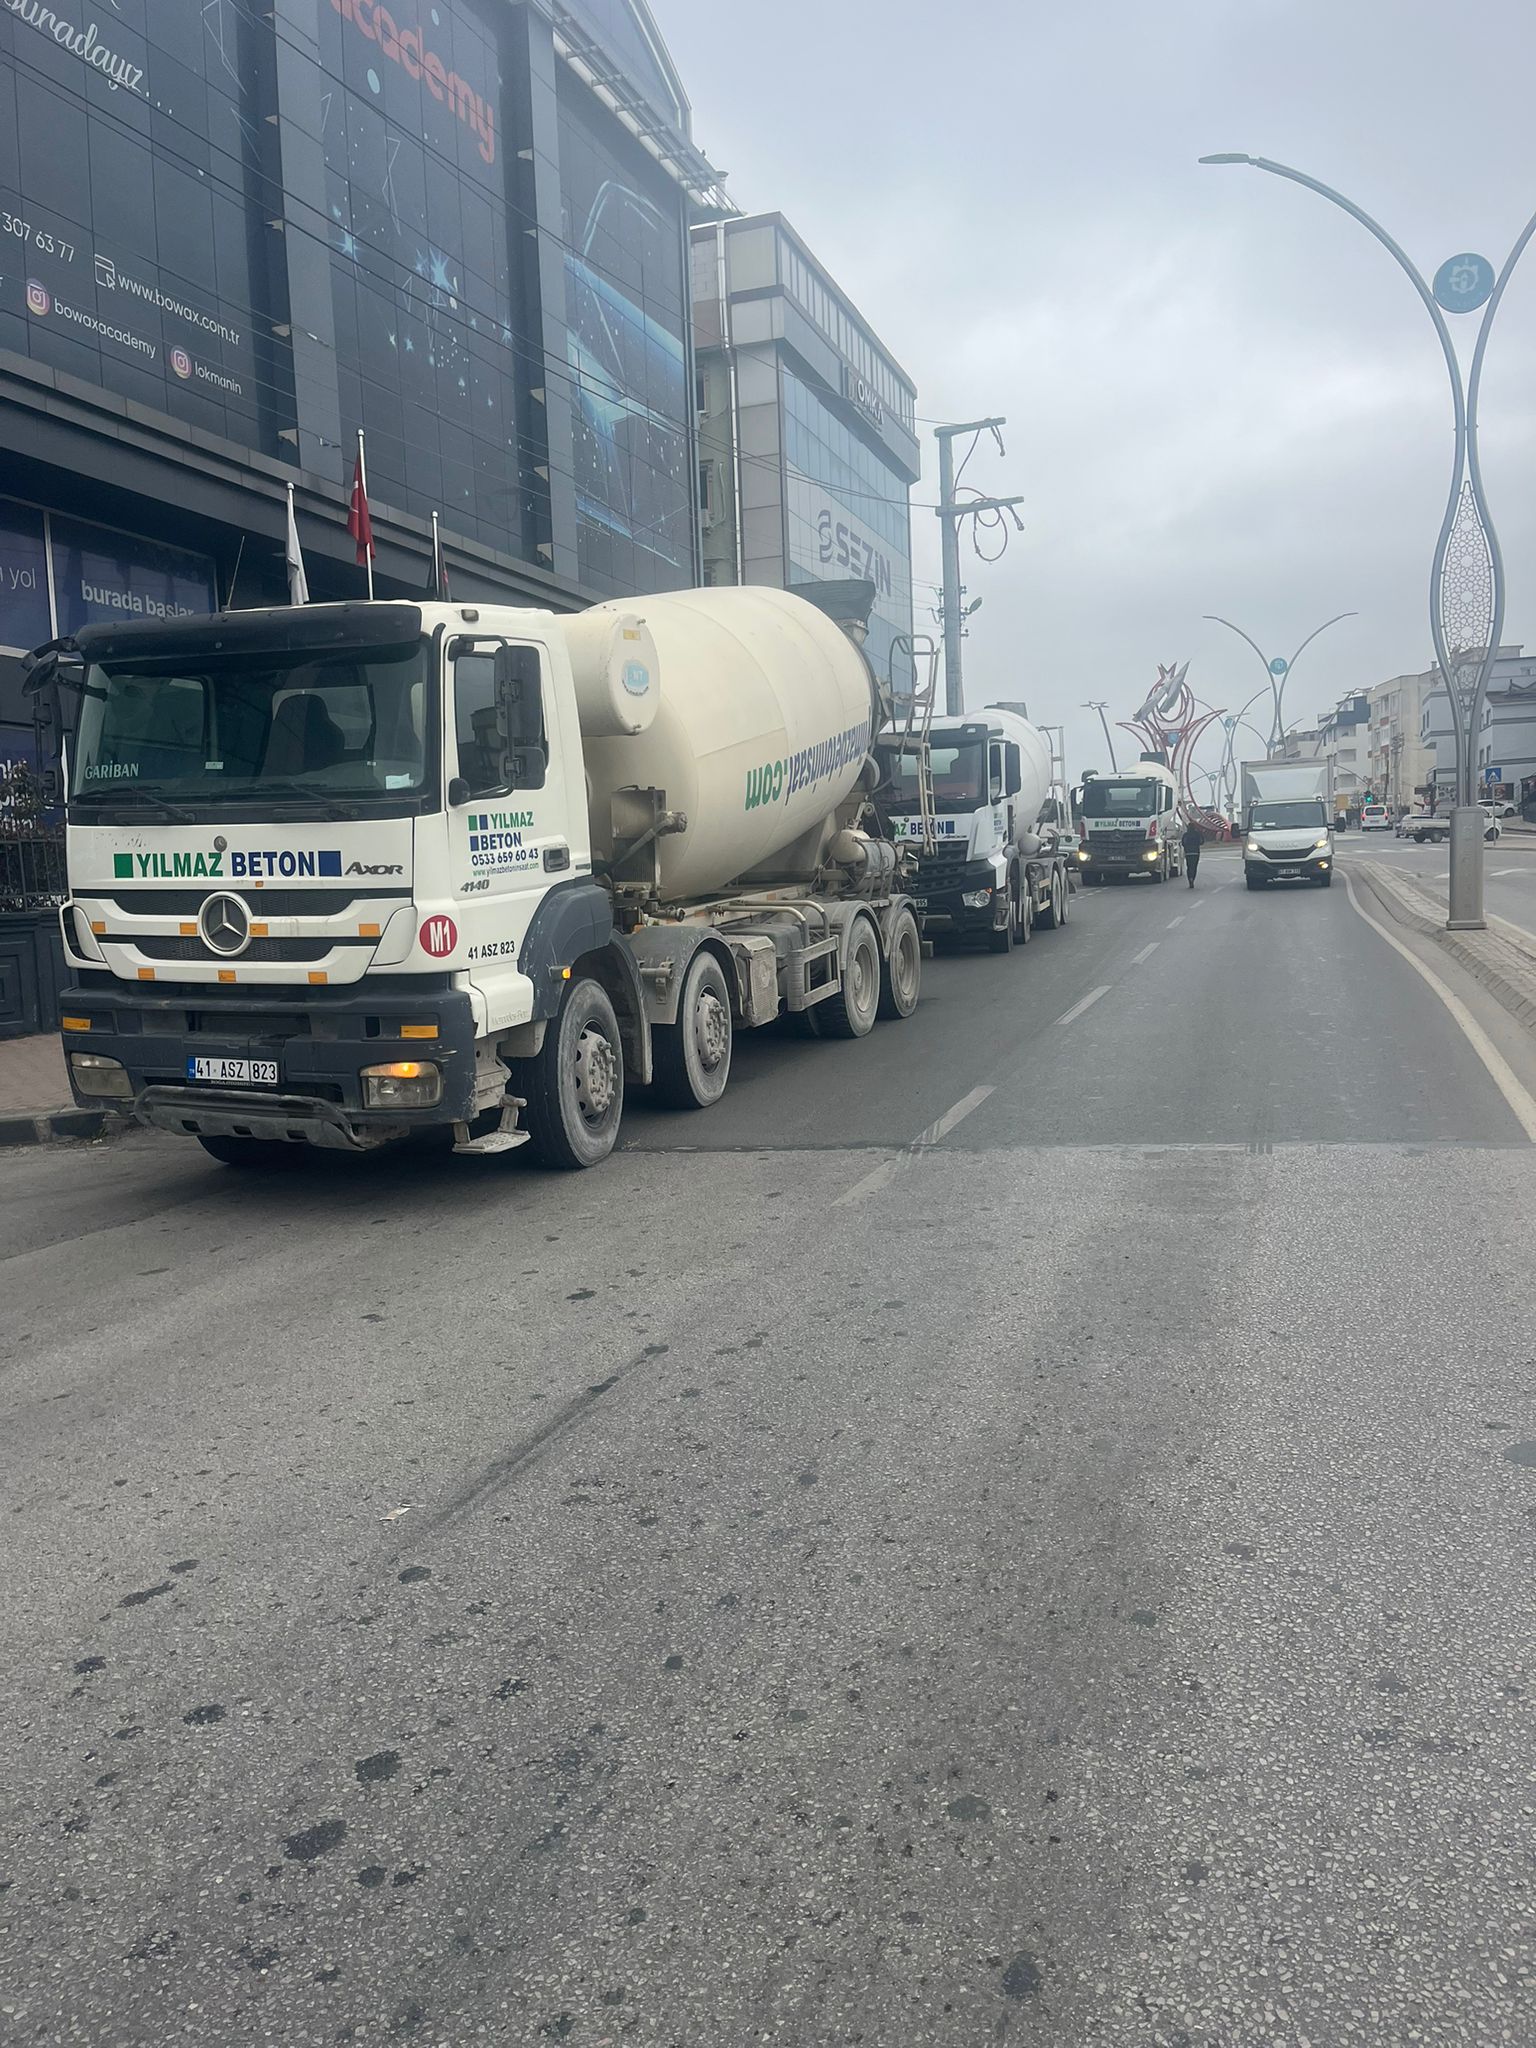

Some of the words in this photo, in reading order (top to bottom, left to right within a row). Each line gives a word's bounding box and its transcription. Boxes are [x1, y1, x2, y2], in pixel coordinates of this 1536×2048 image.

[2, 211, 31, 241] 307
[35, 230, 54, 254] 63
[58, 239, 75, 263] 77
[118, 274, 240, 346] www.bowax.com.tr
[54, 298, 156, 359] bowaxacademy
[9, 567, 36, 590] yol
[81, 579, 143, 613] burada
[84, 760, 139, 780] GARİBAN
[490, 811, 534, 829] YILMAZ
[910, 821, 945, 835] BEN
[480, 832, 522, 850] BETON
[136, 852, 223, 878] YILMAZ
[231, 851, 315, 878] BETON
[471, 852, 495, 866] 0533
[497, 851, 513, 864] 659
[515, 850, 526, 861] 60
[529, 848, 539, 859] 43
[461, 879, 490, 892] 4140
[429, 920, 451, 953] M1
[468, 946, 478, 960] 41
[481, 943, 498, 958] ASZ
[500, 940, 515, 955] 823
[196, 1060, 211, 1077] 41
[221, 1061, 244, 1078] ASZ
[252, 1063, 277, 1080] 823
